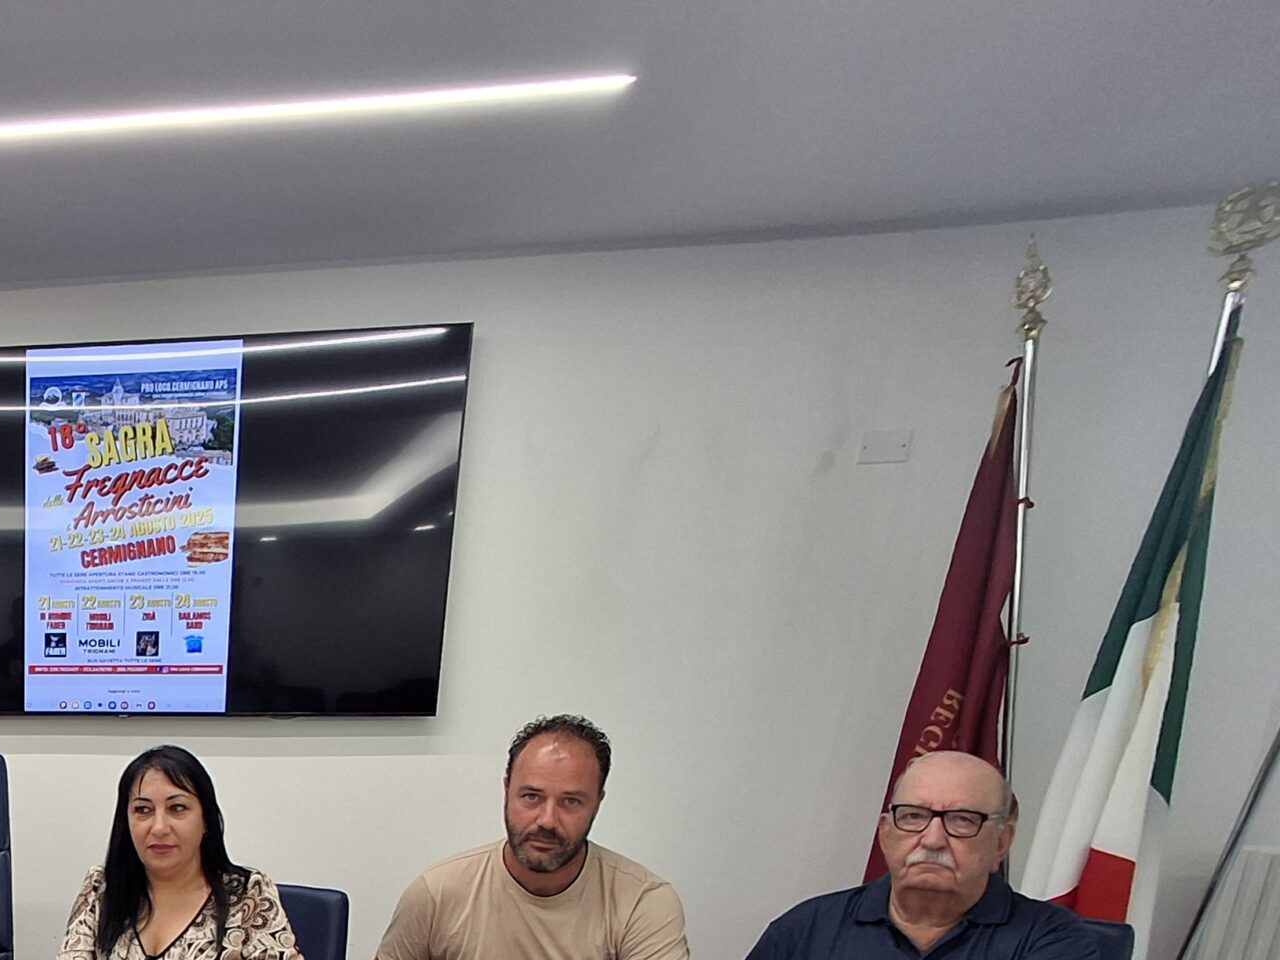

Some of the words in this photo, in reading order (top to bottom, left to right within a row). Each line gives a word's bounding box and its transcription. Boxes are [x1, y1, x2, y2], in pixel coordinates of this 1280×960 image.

[48, 423, 88, 452] 18°
[84, 418, 175, 468] SAGRA
[63, 456, 211, 507] Fregnacce
[73, 487, 194, 531] Arrosticini
[80, 535, 177, 569] CERMIGNANO
[38, 596, 52, 611] 21
[82, 594, 97, 611] 22
[129, 594, 145, 609] 23
[175, 593, 193, 609] 24
[78, 639, 120, 648] MOBILI
